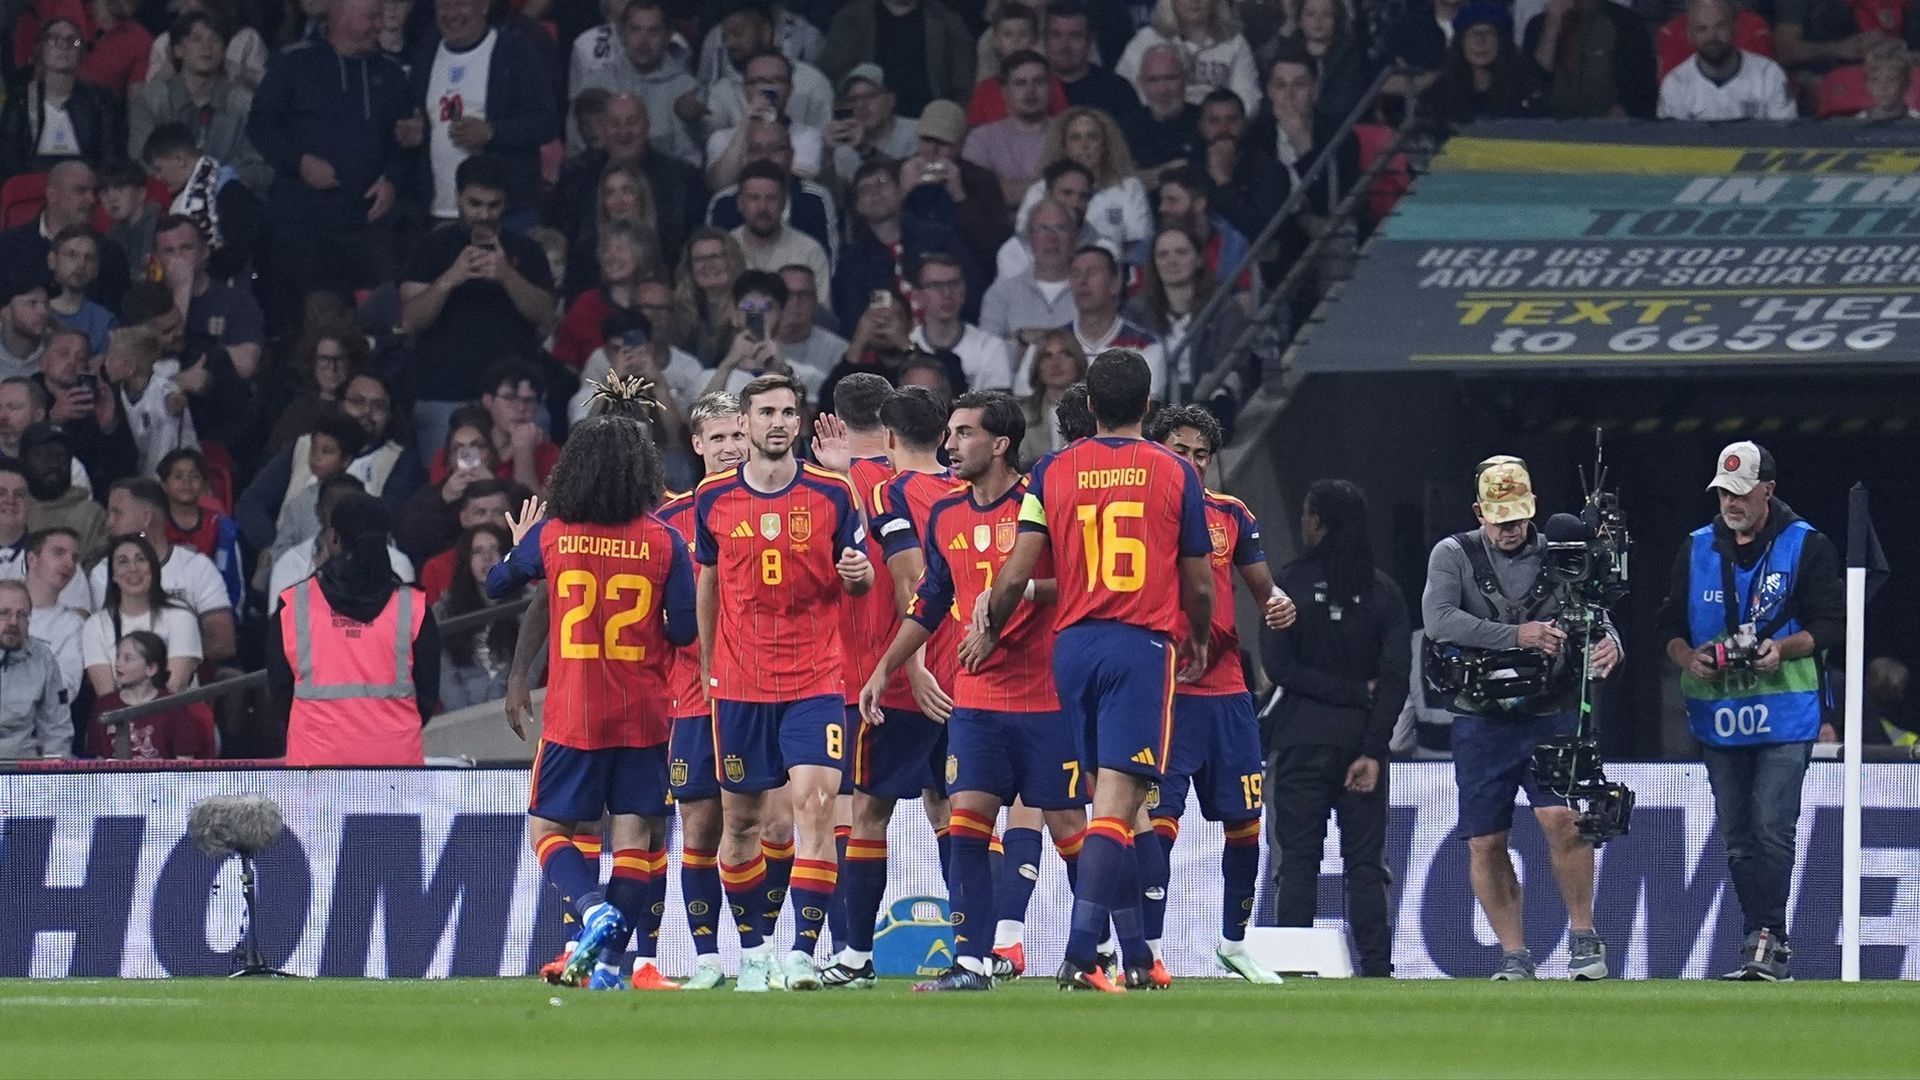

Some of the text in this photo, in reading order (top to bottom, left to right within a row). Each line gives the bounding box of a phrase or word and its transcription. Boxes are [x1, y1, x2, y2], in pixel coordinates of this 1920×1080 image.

[1672, 176, 1791, 203] IN
[1417, 247, 1538, 267] HELP
[1545, 247, 1610, 266] US
[1618, 246, 1747, 266] STOP
[1418, 267, 1523, 288] AND
[1525, 265, 1828, 287] ANTI-SOCIAL
[1455, 299, 1713, 325] TEXT:
[1490, 322, 1898, 353] to 66566
[1078, 467, 1147, 490] RODRIGO
[558, 535, 651, 560] CUCURELLA
[1076, 501, 1147, 592] 16
[761, 548, 783, 585] 8
[975, 561, 993, 592] 7
[1703, 590, 1740, 603] UE
[557, 569, 652, 661] 22
[1714, 703, 1771, 737] 002
[826, 723, 843, 760] 8
[1062, 759, 1081, 799] 7
[1240, 773, 1262, 810] 19
